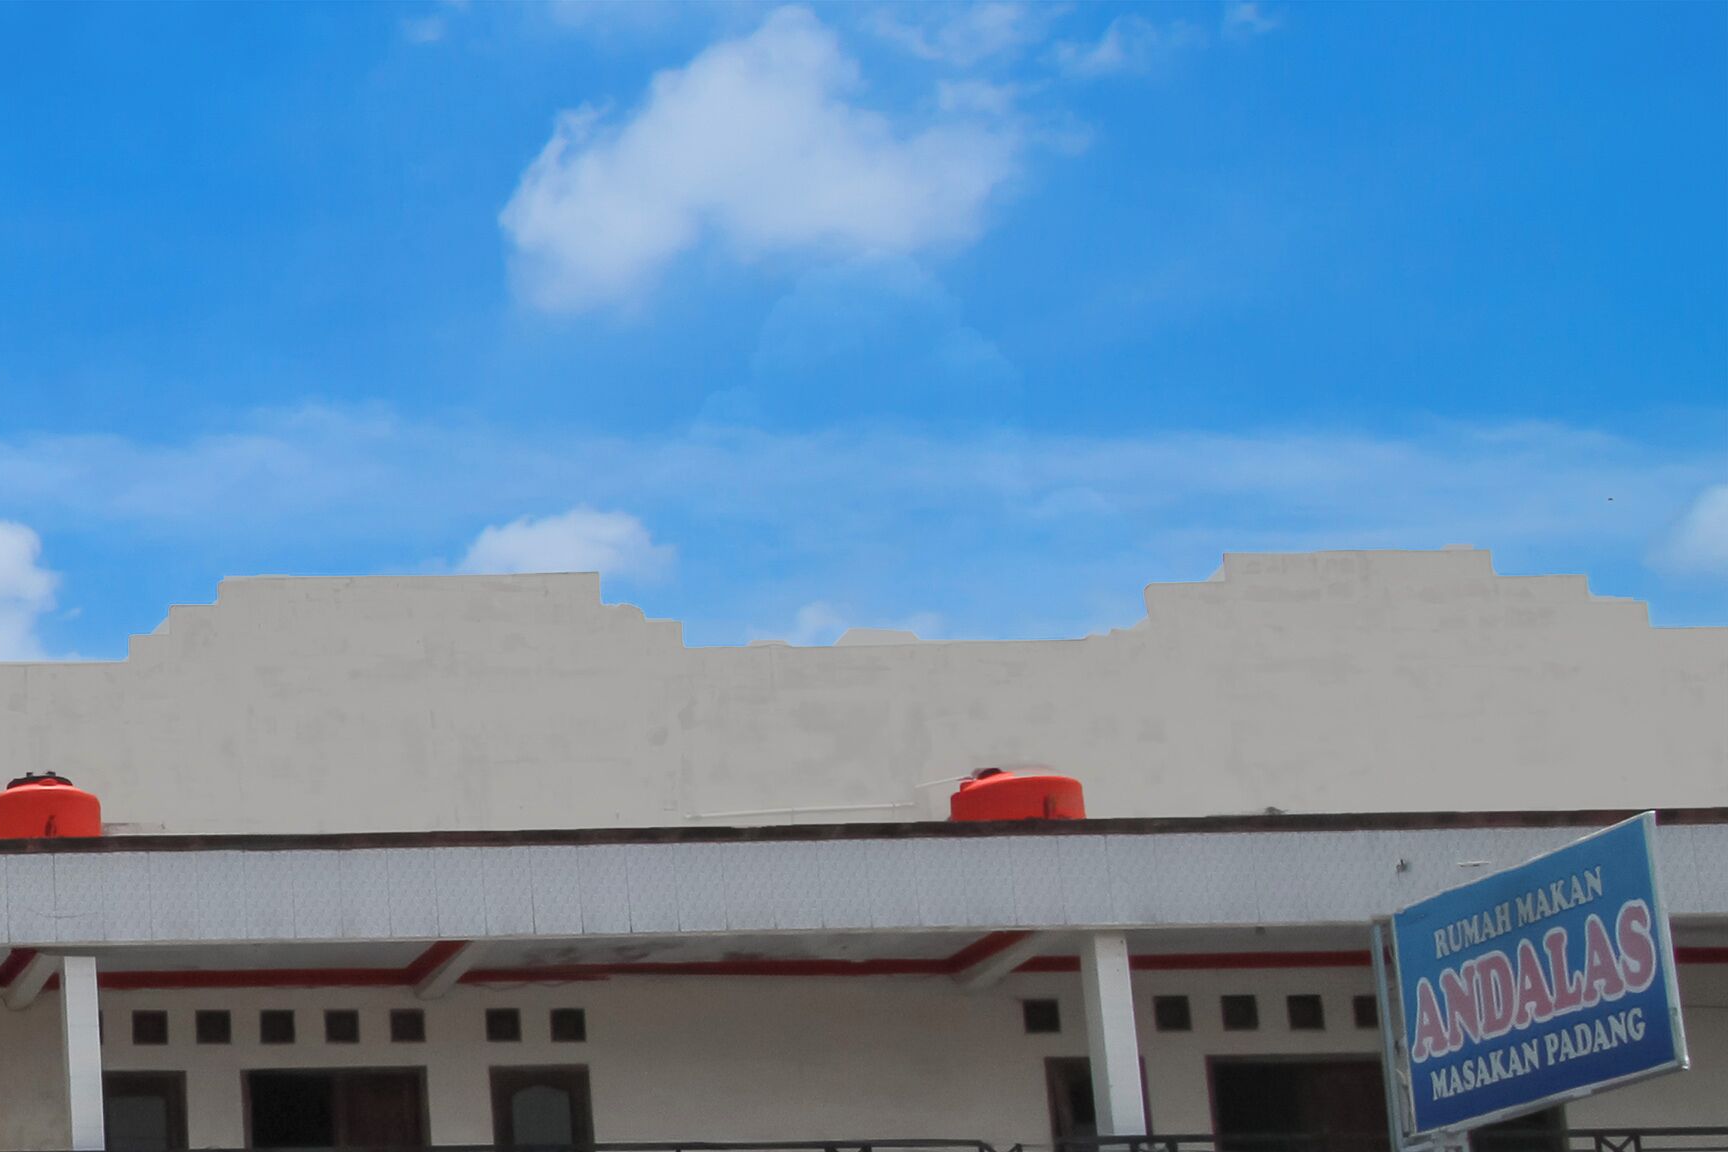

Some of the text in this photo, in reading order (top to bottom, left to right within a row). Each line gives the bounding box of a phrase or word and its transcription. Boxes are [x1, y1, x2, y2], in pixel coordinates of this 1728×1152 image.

[1434, 866, 1604, 959] RUMAH MAKAN
[1412, 899, 1657, 1063] ANDALAS
[1431, 1008, 1647, 1101] MASAKAN PADANG
